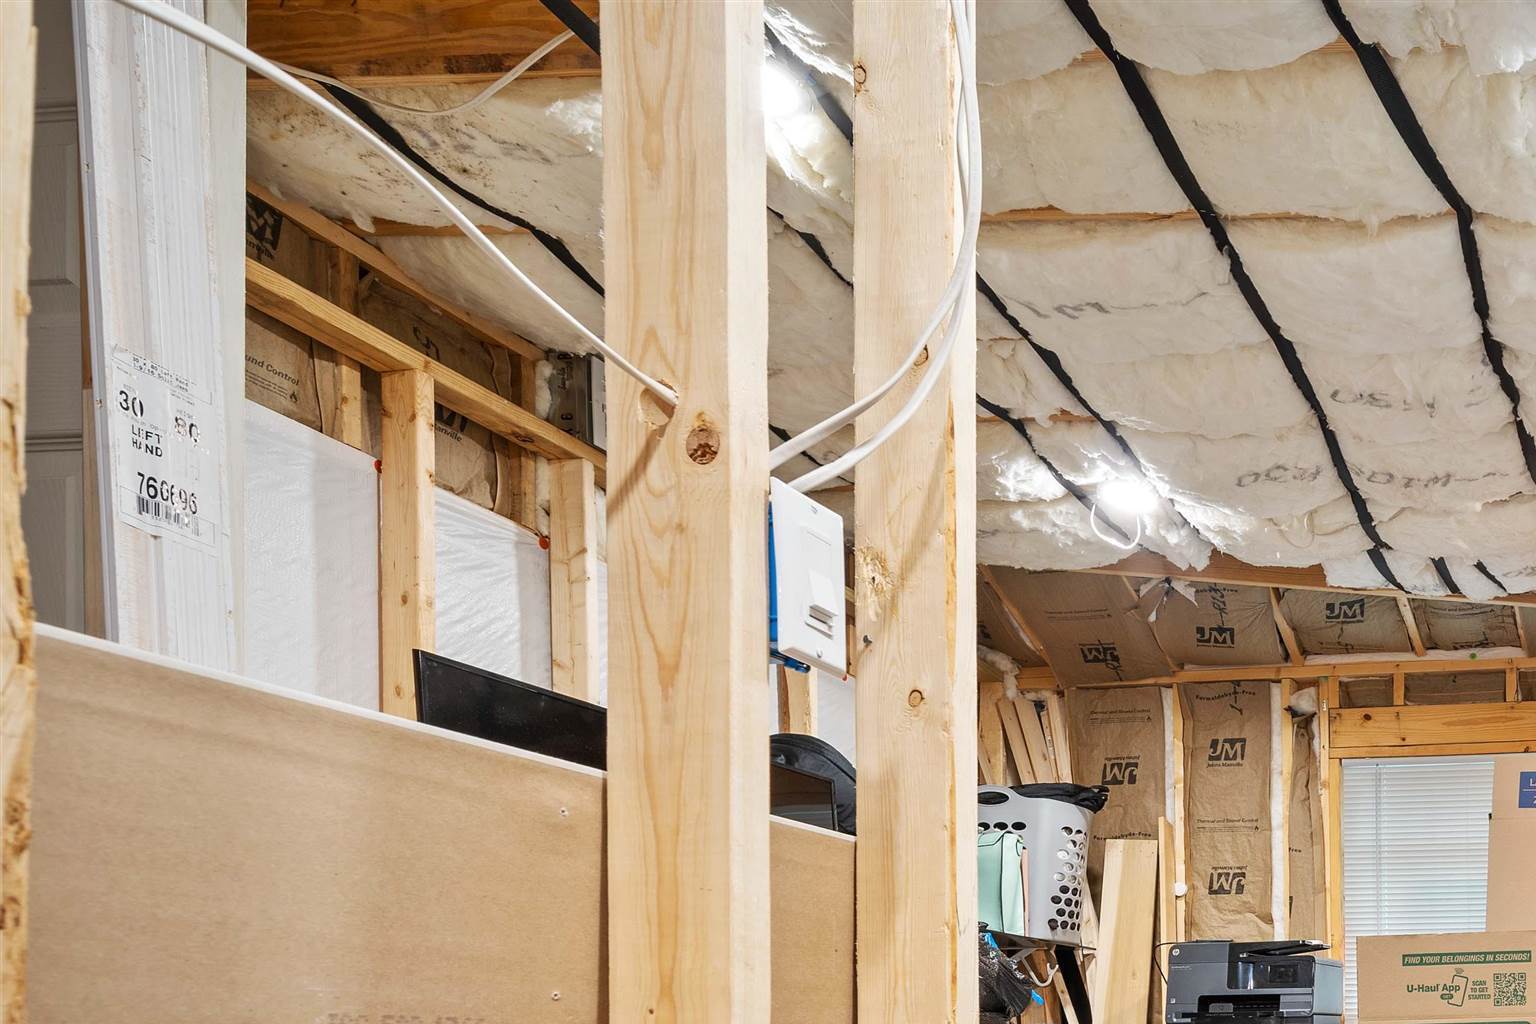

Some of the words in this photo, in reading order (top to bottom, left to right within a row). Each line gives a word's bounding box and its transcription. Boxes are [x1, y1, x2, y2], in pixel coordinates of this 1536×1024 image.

[245, 353, 266, 368] und
[434, 423, 463, 443] anville
[1208, 737, 1246, 761] JM
[1404, 956, 1420, 964] FIND
[1422, 955, 1441, 963] YOUR
[1441, 954, 1485, 963] BELONGINGS
[1495, 953, 1530, 961] SECONDS!
[1441, 983, 1461, 993] App
